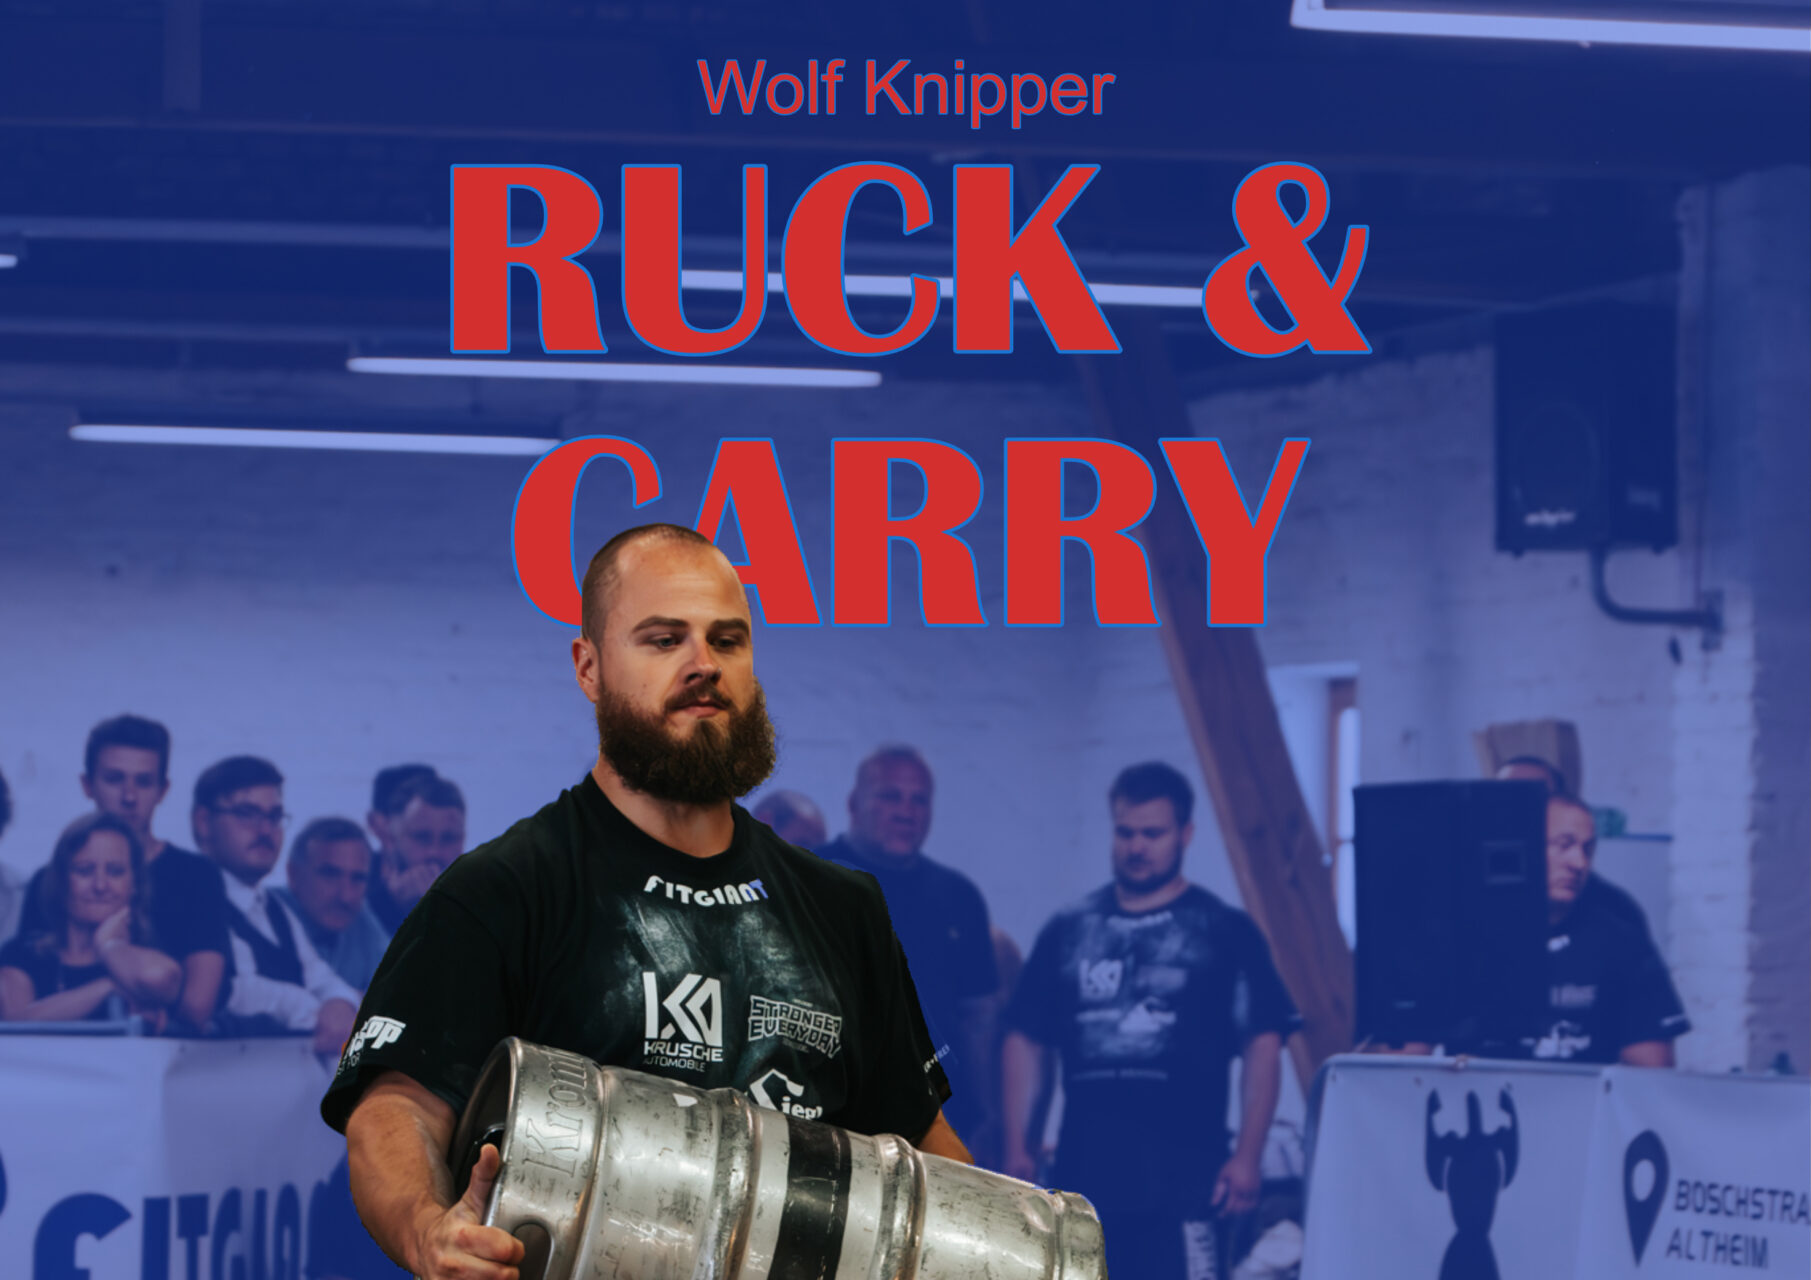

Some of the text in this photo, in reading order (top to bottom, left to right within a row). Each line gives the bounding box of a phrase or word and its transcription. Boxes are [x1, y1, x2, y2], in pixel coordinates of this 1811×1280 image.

[643, 875, 768, 907] FITGIANT
[750, 995, 842, 1037] STRONGER
[643, 1041, 724, 1062] KRUSCHE
[748, 1016, 841, 1059] EVERYDAY
[1675, 1179, 1811, 1226] BOSCHSTRA
[1666, 1227, 1770, 1270] ALTHEIM
